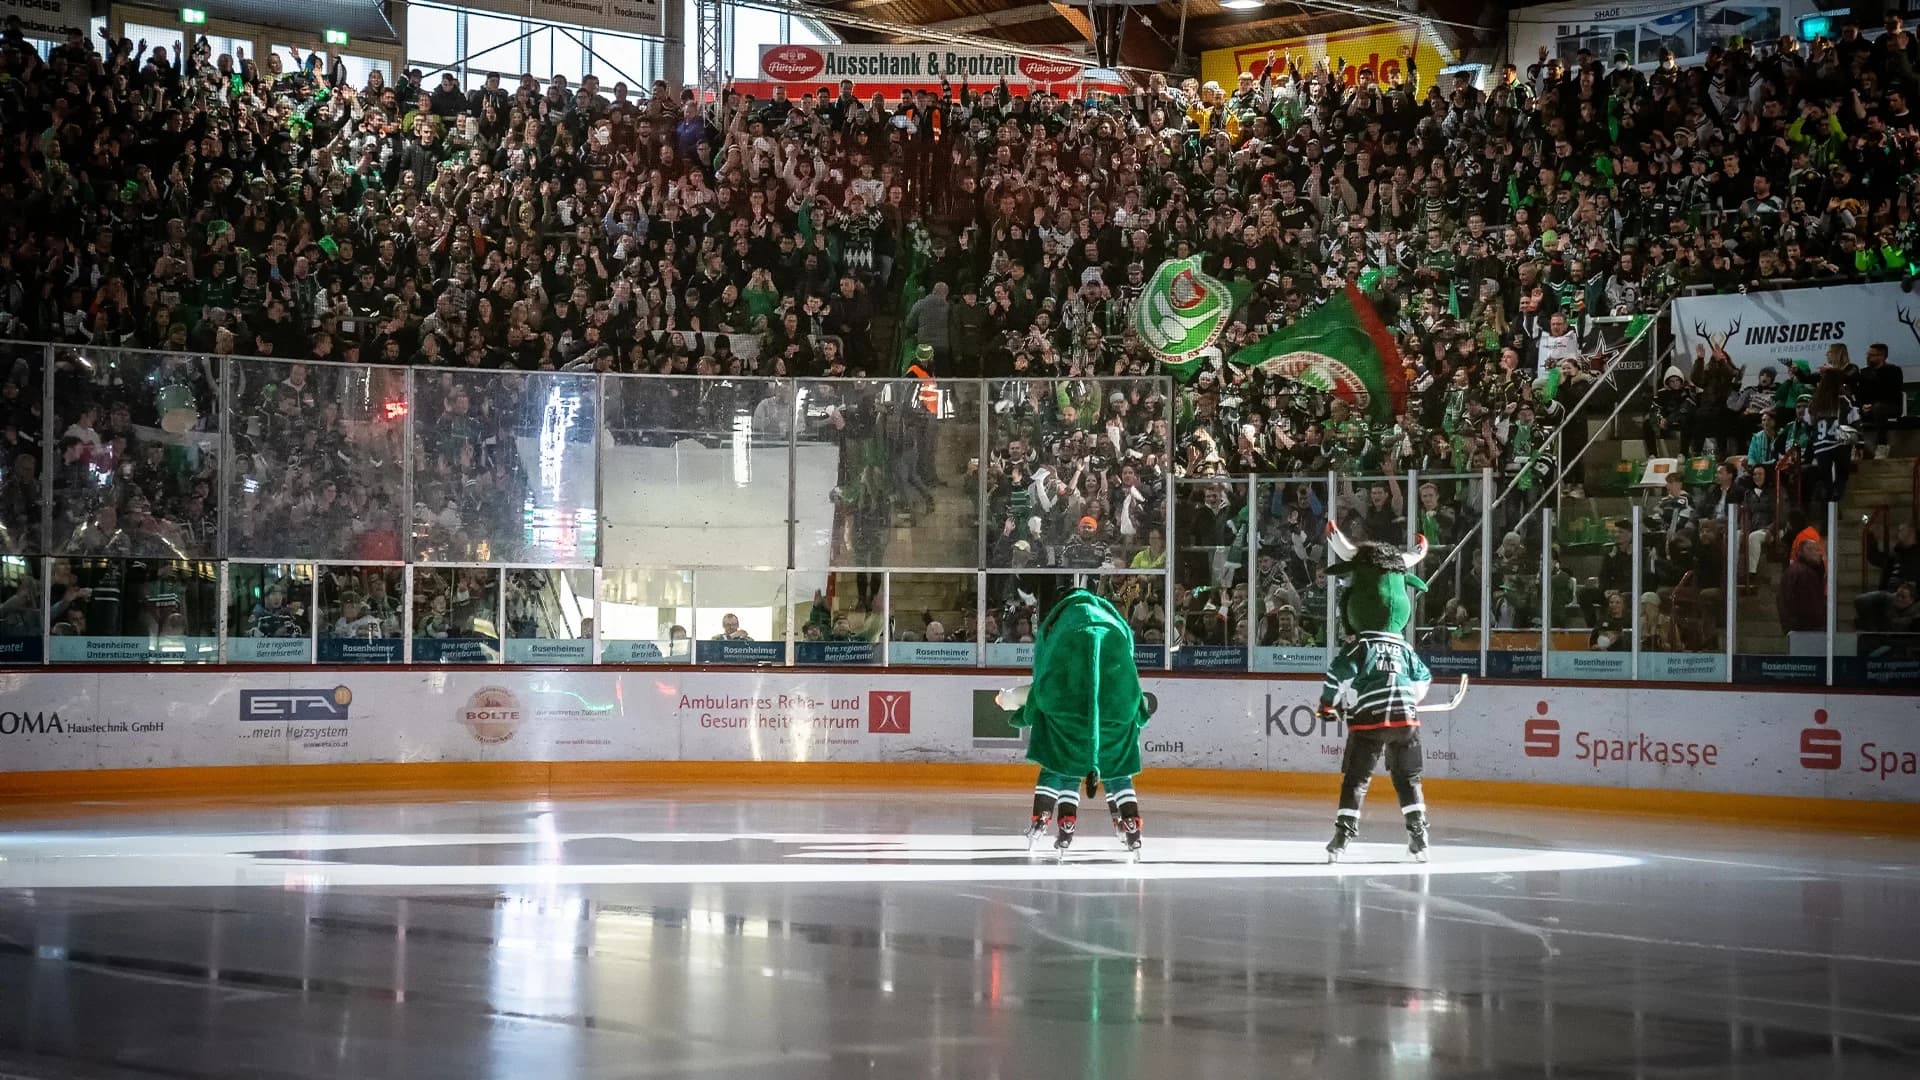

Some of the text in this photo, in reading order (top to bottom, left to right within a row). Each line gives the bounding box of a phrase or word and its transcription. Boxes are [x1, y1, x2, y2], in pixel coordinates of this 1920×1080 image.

[1594, 8, 1620, 19] SHADE
[825, 52, 1016, 76] Ausschank & Brotzeit
[1745, 321, 1846, 345] INNSIDERS
[1770, 343, 1829, 352] WERBEAGENT
[1817, 419, 1840, 441] 94
[0, 641, 24, 653] ente!
[86, 641, 139, 649] Rosenheimer
[342, 644, 394, 652] Rosenheimer
[532, 644, 585, 652] Rosenheimer
[723, 646, 777, 654] Rosenheimer
[916, 648, 969, 657] Rosenheimer
[1430, 655, 1478, 664] Rosenheimer
[1573, 657, 1624, 666] Rosenheimer
[1761, 662, 1817, 671] Rosenheimer
[250, 696, 337, 714] ETA
[831, 695, 860, 710] und
[466, 711, 520, 720] BOLTE
[67, 720, 128, 733] Haustechnik
[131, 721, 164, 733] GmbH
[286, 725, 348, 739] Heizsystem
[1144, 740, 1184, 753] GmbH
[1575, 731, 1718, 767] Sparkasse
